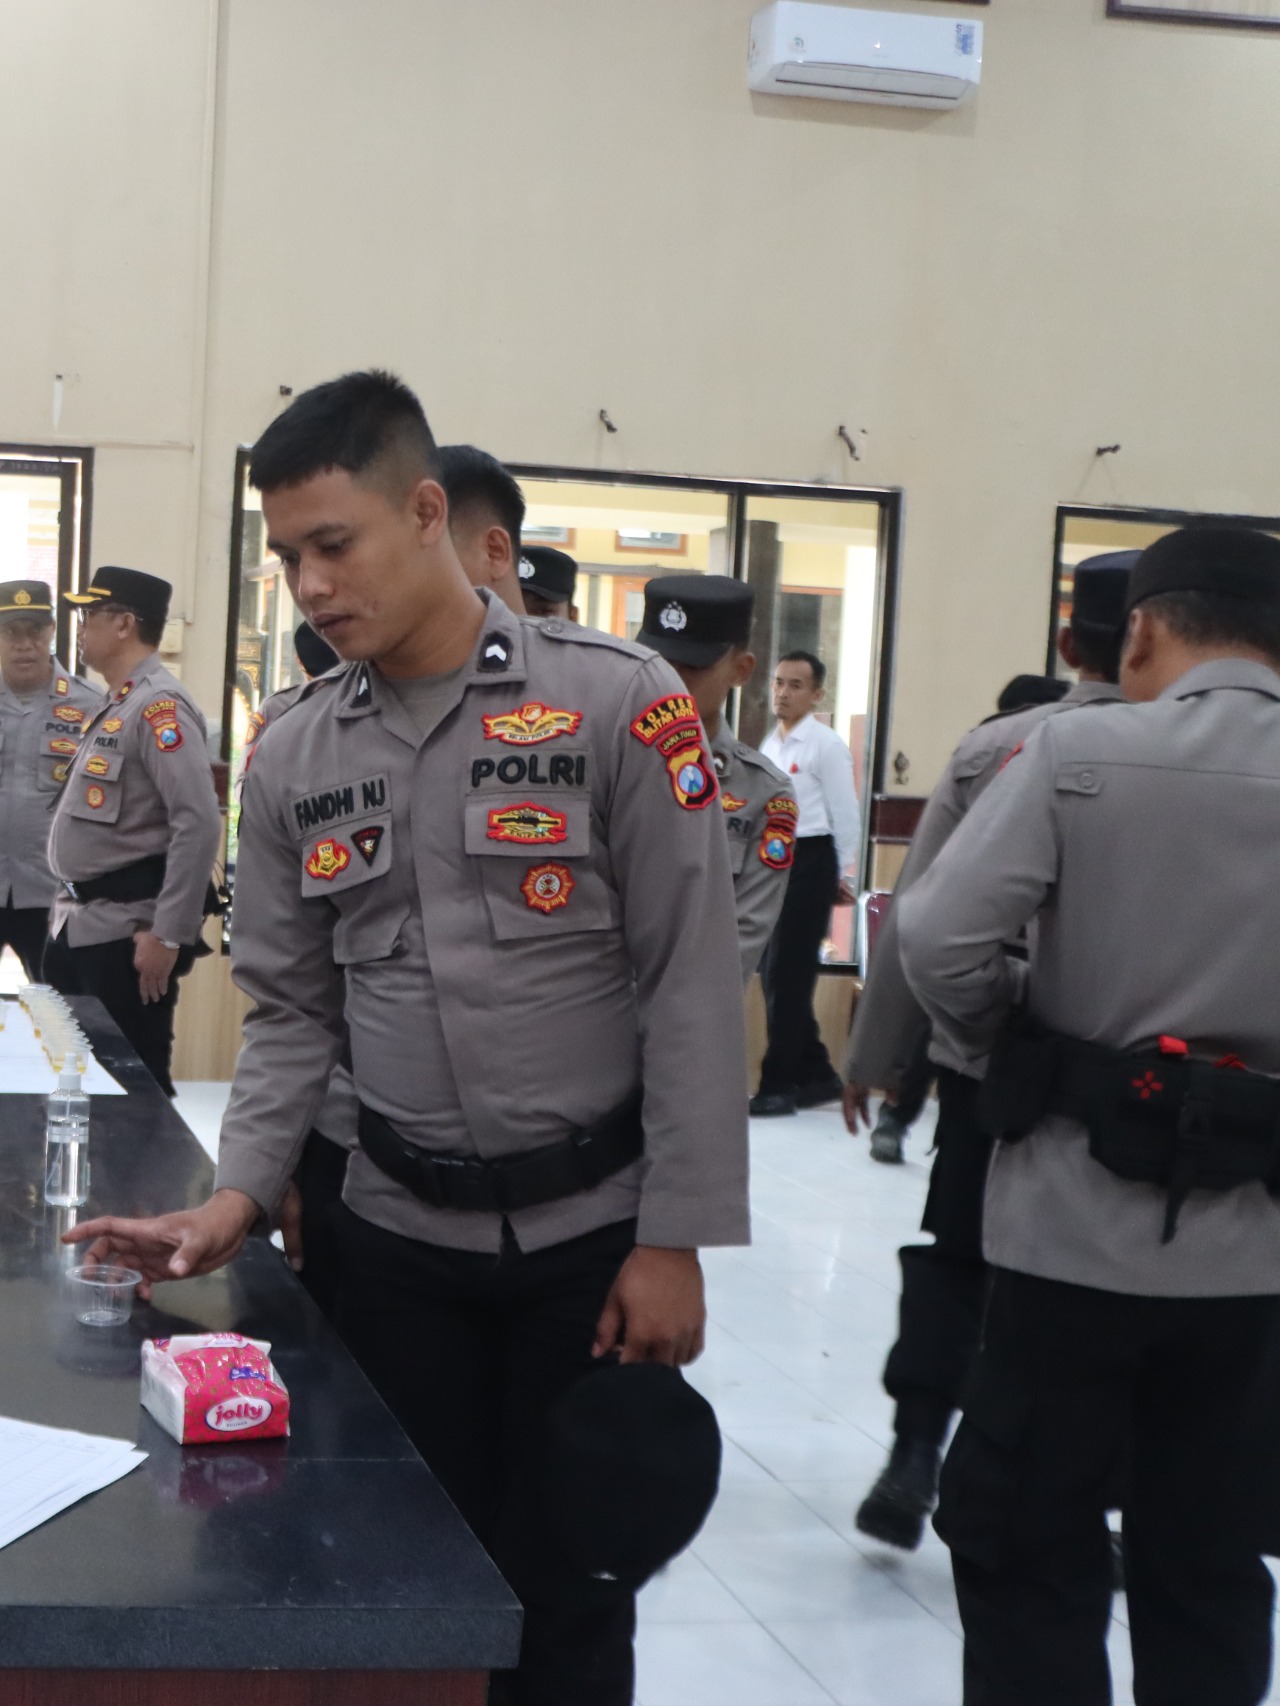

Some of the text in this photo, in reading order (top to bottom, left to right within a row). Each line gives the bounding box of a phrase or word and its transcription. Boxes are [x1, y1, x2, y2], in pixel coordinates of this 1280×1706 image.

[635, 698, 694, 734] POLRES
[674, 708, 695, 718] KOTA
[46, 722, 81, 735] POLR
[94, 736, 118, 749] POLRI
[471, 753, 586, 788] POLRI
[294, 778, 386, 831] FANDHI NJ
[215, 1403, 263, 1425] jolly
